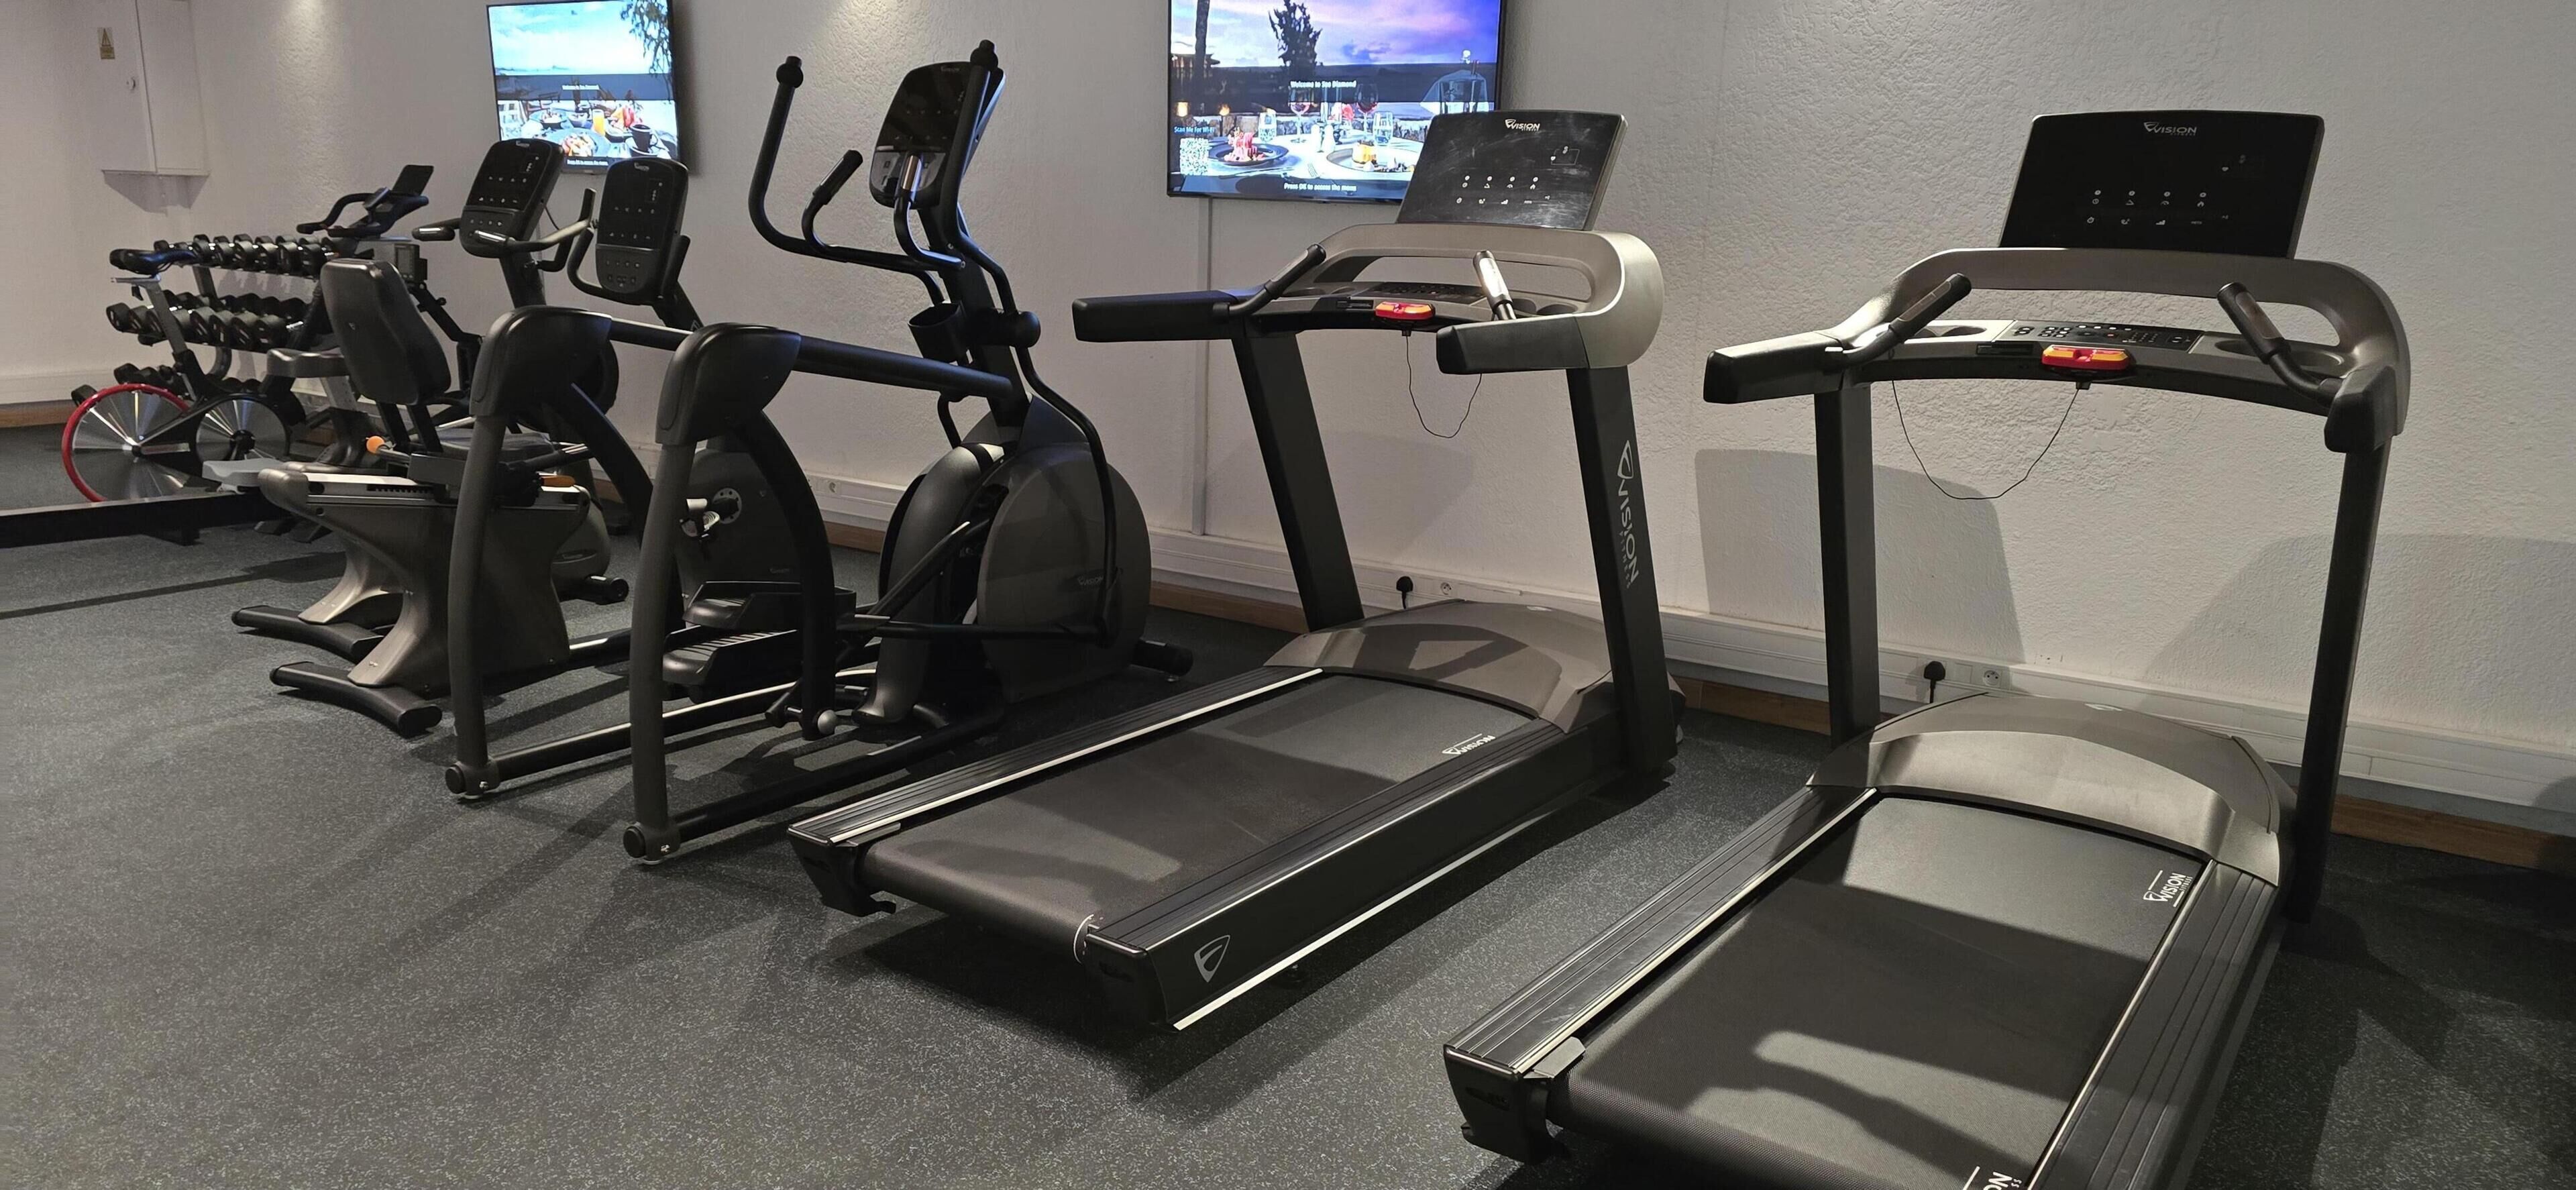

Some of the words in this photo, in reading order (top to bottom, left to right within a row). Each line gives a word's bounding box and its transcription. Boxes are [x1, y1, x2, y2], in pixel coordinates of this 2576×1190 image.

[1332, 80, 1356, 88] Diamond
[1618, 479, 1639, 583] VISION
[2160, 873, 2186, 898] VISION
